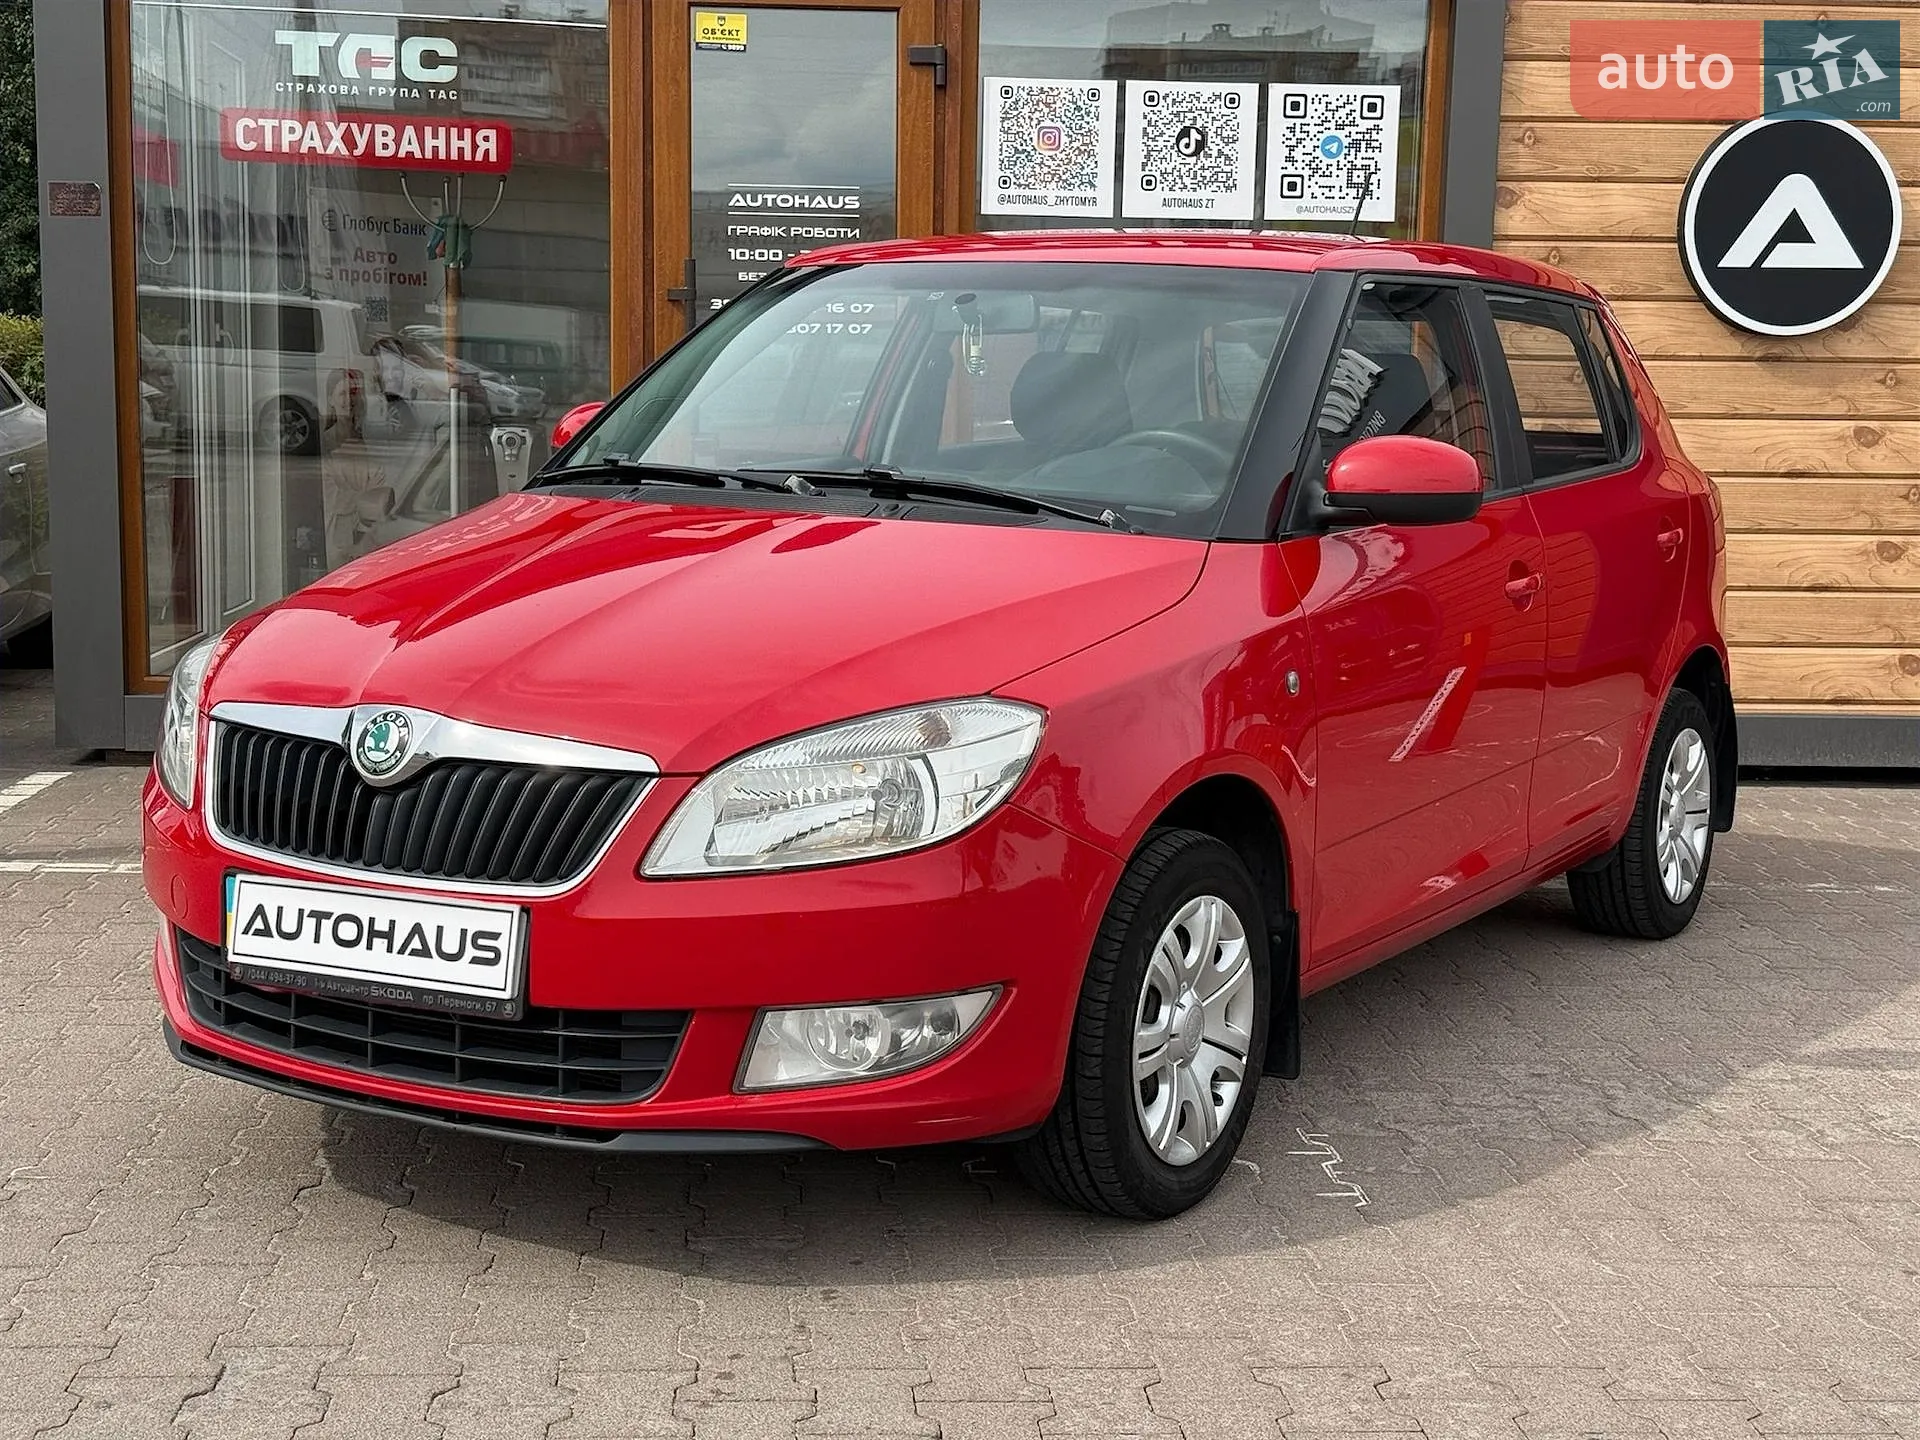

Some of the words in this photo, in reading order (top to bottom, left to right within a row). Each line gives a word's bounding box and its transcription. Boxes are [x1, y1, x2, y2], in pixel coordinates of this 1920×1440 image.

[275, 30, 458, 83] ТАС
[275, 81, 360, 96] СТРАХОВА
[368, 86, 420, 99] ГРУПА
[428, 88, 458, 101] ТАС
[235, 117, 498, 163] СТРАХУВАННЯ
[728, 193, 861, 209] AUTOHAUS
[997, 193, 1098, 207] @AUTOHAUS_ZHYTOMYR
[1161, 197, 1204, 209] AUTOHAUS
[1204, 198, 1216, 209] ZT
[342, 214, 391, 236] Глобус
[393, 218, 427, 236] Банк
[727, 225, 788, 237] ГРАФІК
[790, 227, 861, 239] РОБОТИ
[353, 246, 398, 265] Авто
[728, 248, 783, 261] 10:00
[339, 267, 427, 287] пробігом!
[826, 303, 845, 314] 16
[850, 303, 875, 314] 07
[825, 323, 844, 334] 17
[848, 323, 873, 335] 07
[241, 903, 502, 967] AUTOHAUS
[370, 985, 414, 1001] SKODA
